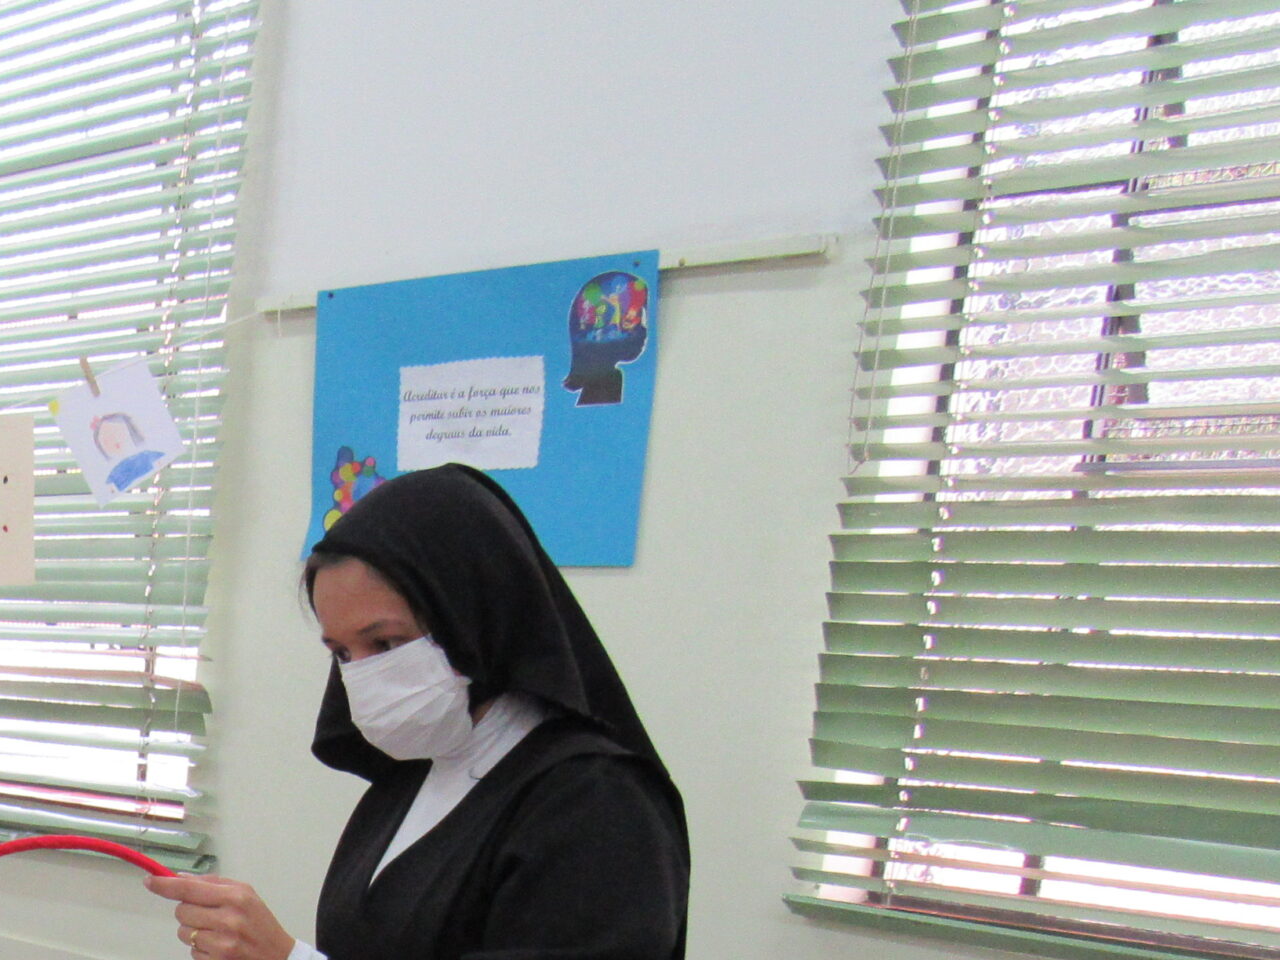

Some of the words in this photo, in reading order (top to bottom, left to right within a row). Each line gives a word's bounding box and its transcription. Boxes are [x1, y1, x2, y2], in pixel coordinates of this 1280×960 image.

[403, 389, 448, 402] Acreditar
[467, 386, 496, 401] força
[499, 386, 520, 400] que
[522, 385, 541, 394] nos
[409, 409, 445, 425] permite
[447, 406, 473, 418] subir
[475, 409, 487, 417] os
[490, 405, 532, 416] maiores
[425, 428, 465, 443] degraus
[468, 426, 482, 438] da
[485, 424, 512, 437] vida.
